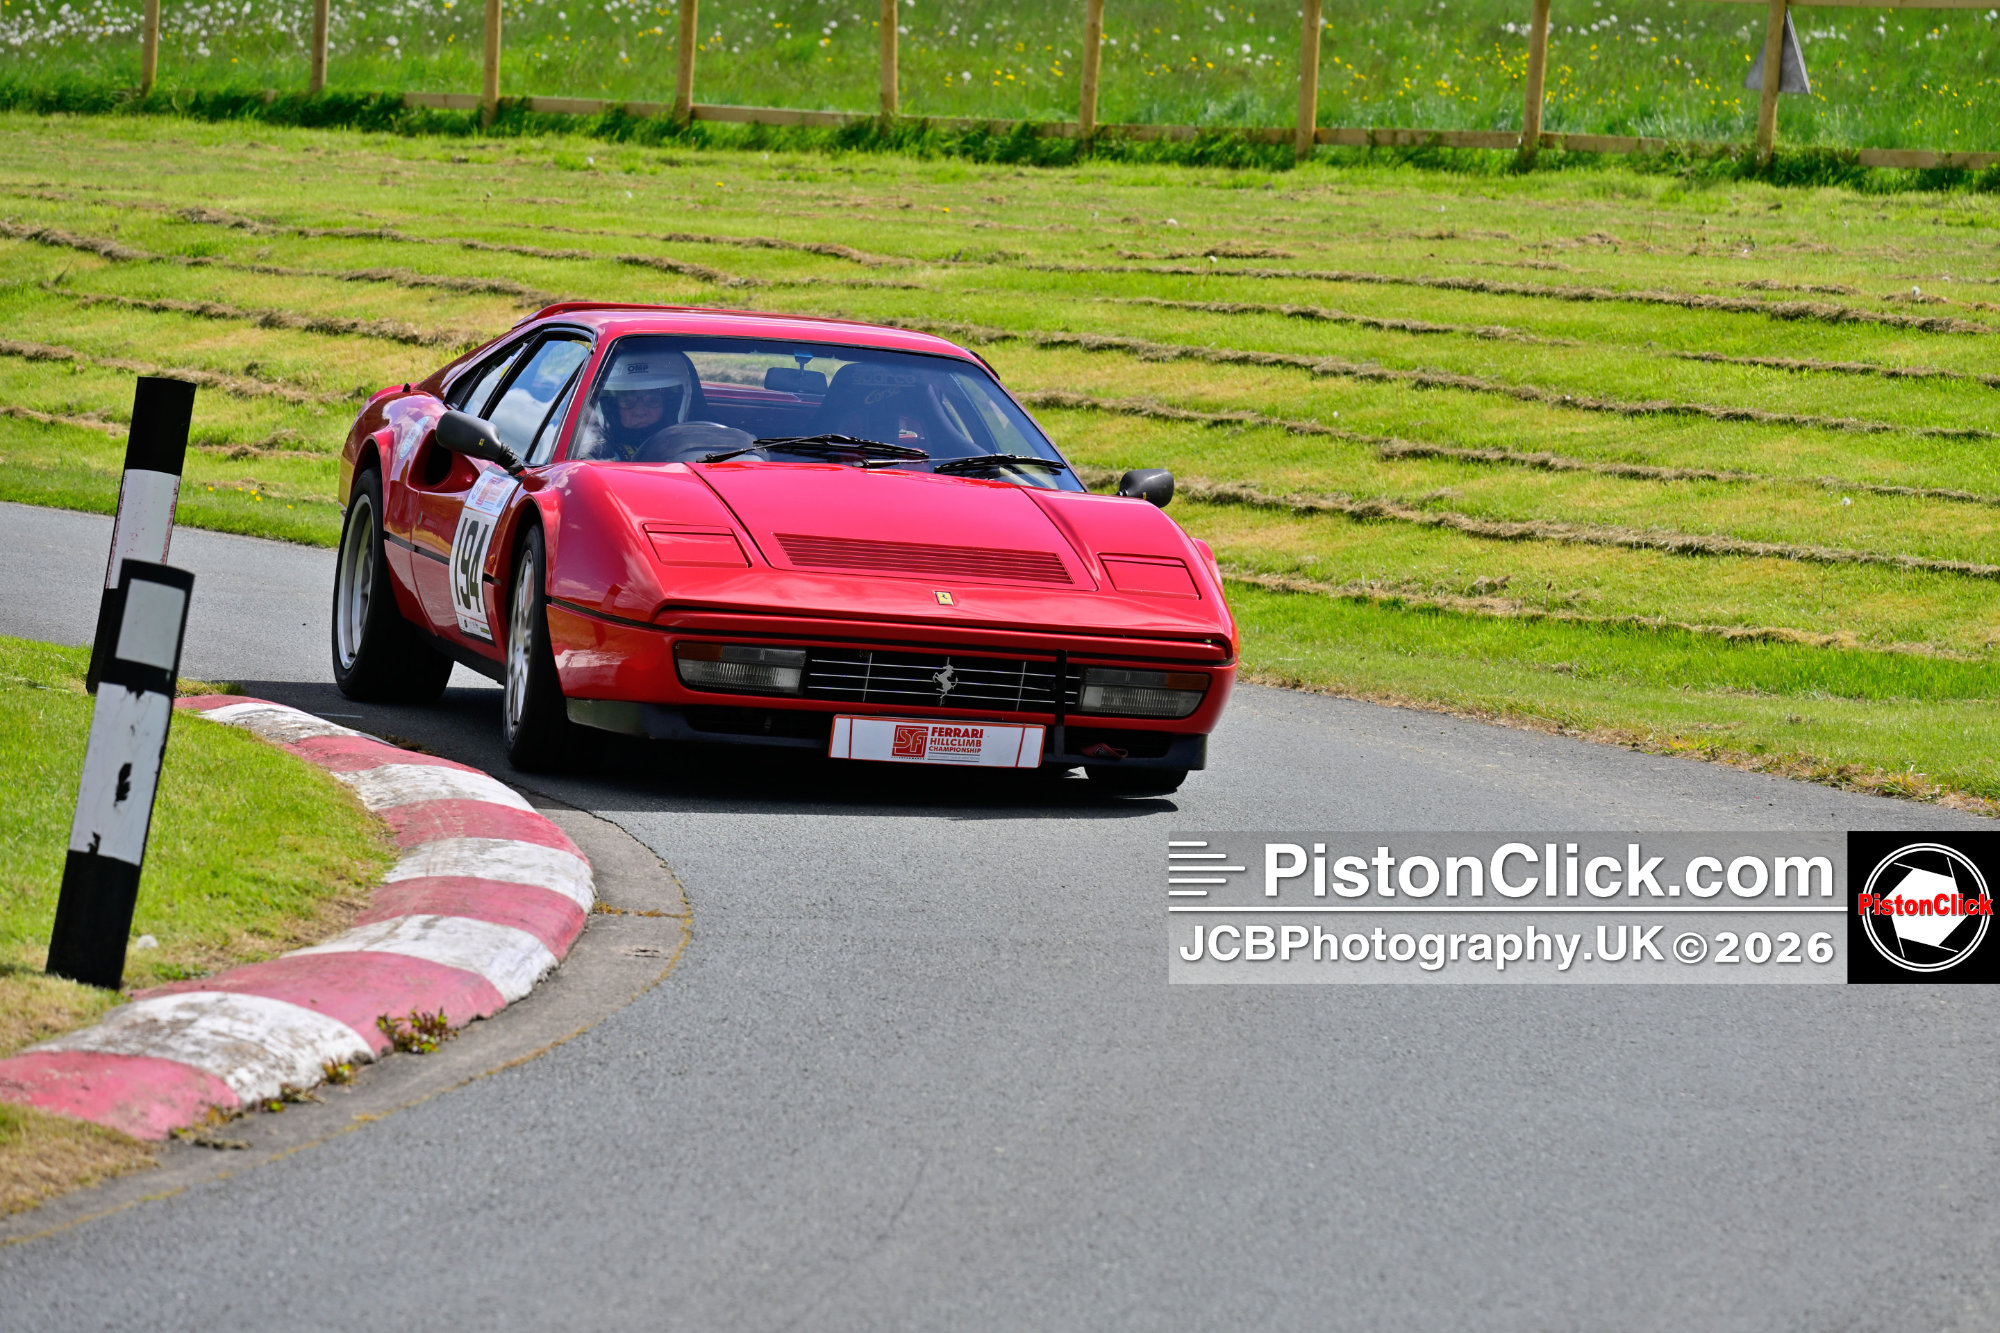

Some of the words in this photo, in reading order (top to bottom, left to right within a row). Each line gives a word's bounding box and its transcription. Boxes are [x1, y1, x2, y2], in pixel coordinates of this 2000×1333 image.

[627, 364, 649, 372] OMP
[454, 517, 489, 613] 194
[931, 726, 984, 739] FERRARI
[930, 737, 982, 748] HILLCLIMB
[928, 745, 982, 754] CHAMPIONSHIP
